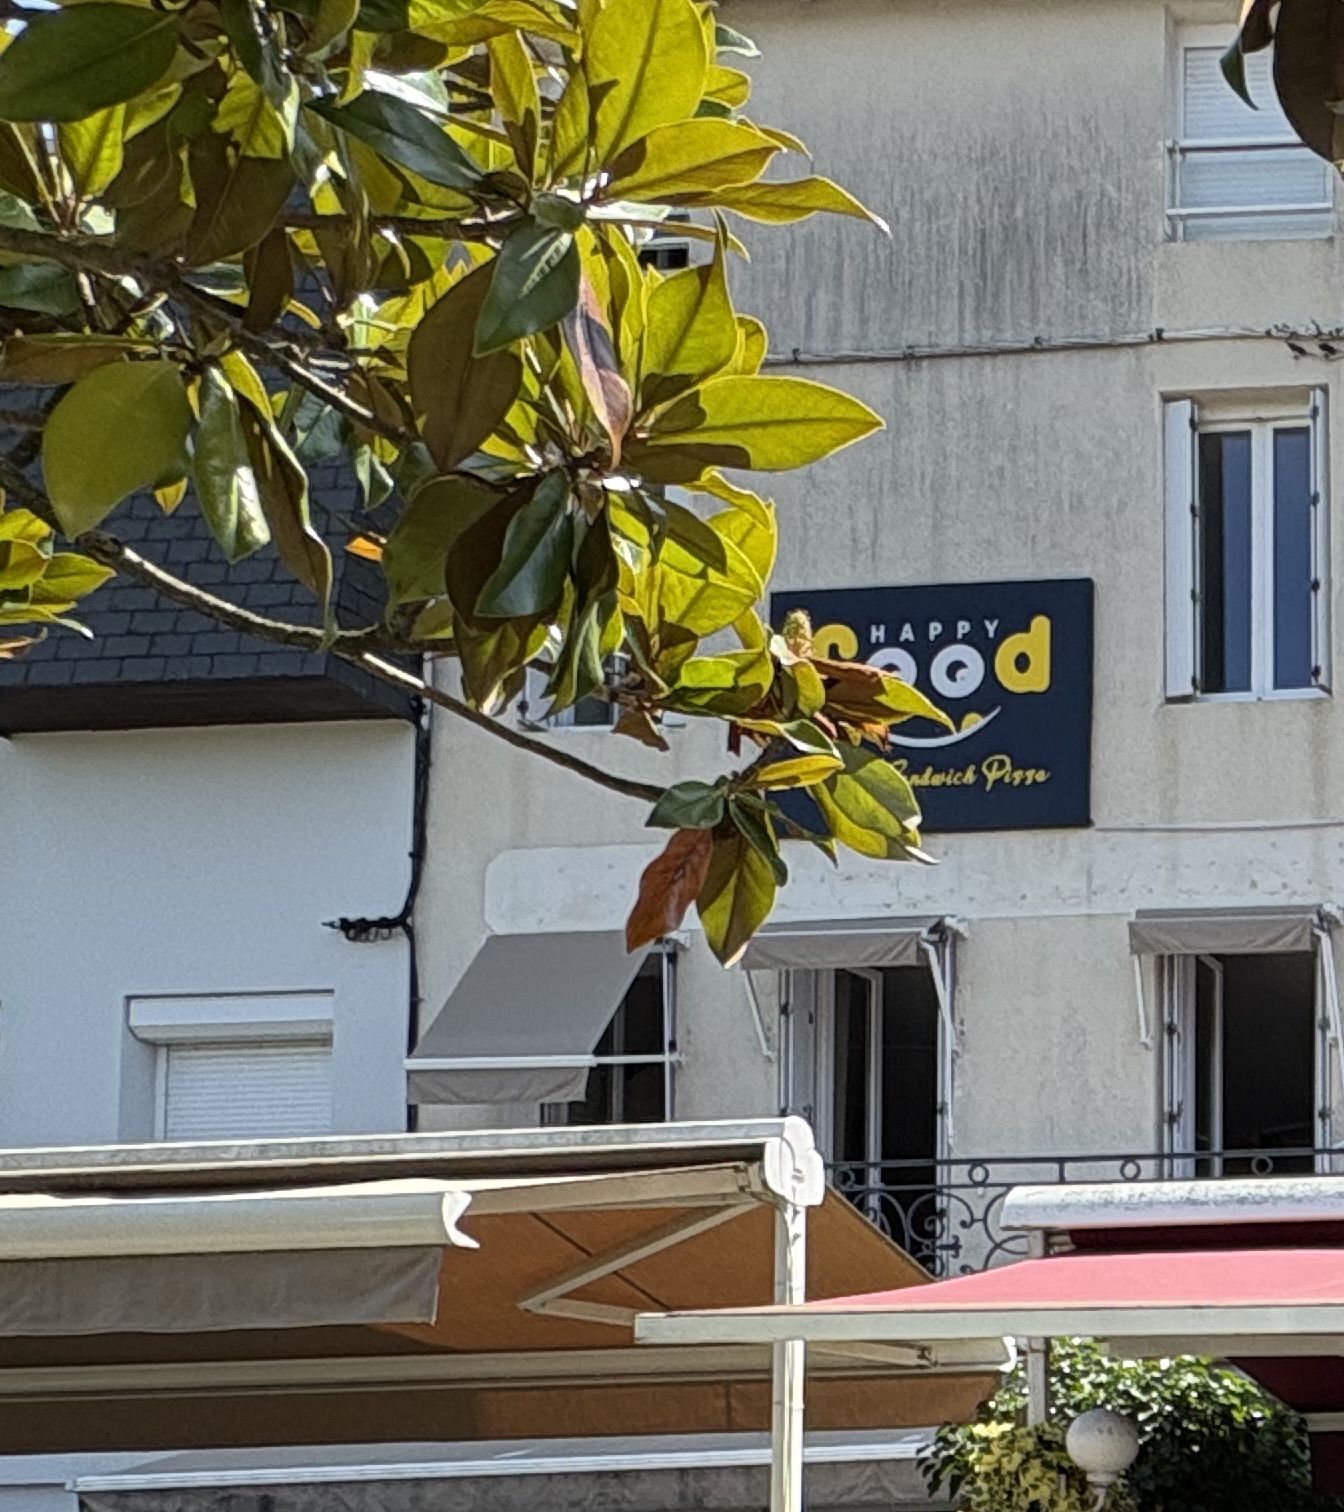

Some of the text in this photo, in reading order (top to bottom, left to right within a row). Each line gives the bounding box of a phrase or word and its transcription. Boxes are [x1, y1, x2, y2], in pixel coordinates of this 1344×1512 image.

[870, 618, 999, 644] HAPPY
[892, 753, 1051, 792] ndwich Pizza
